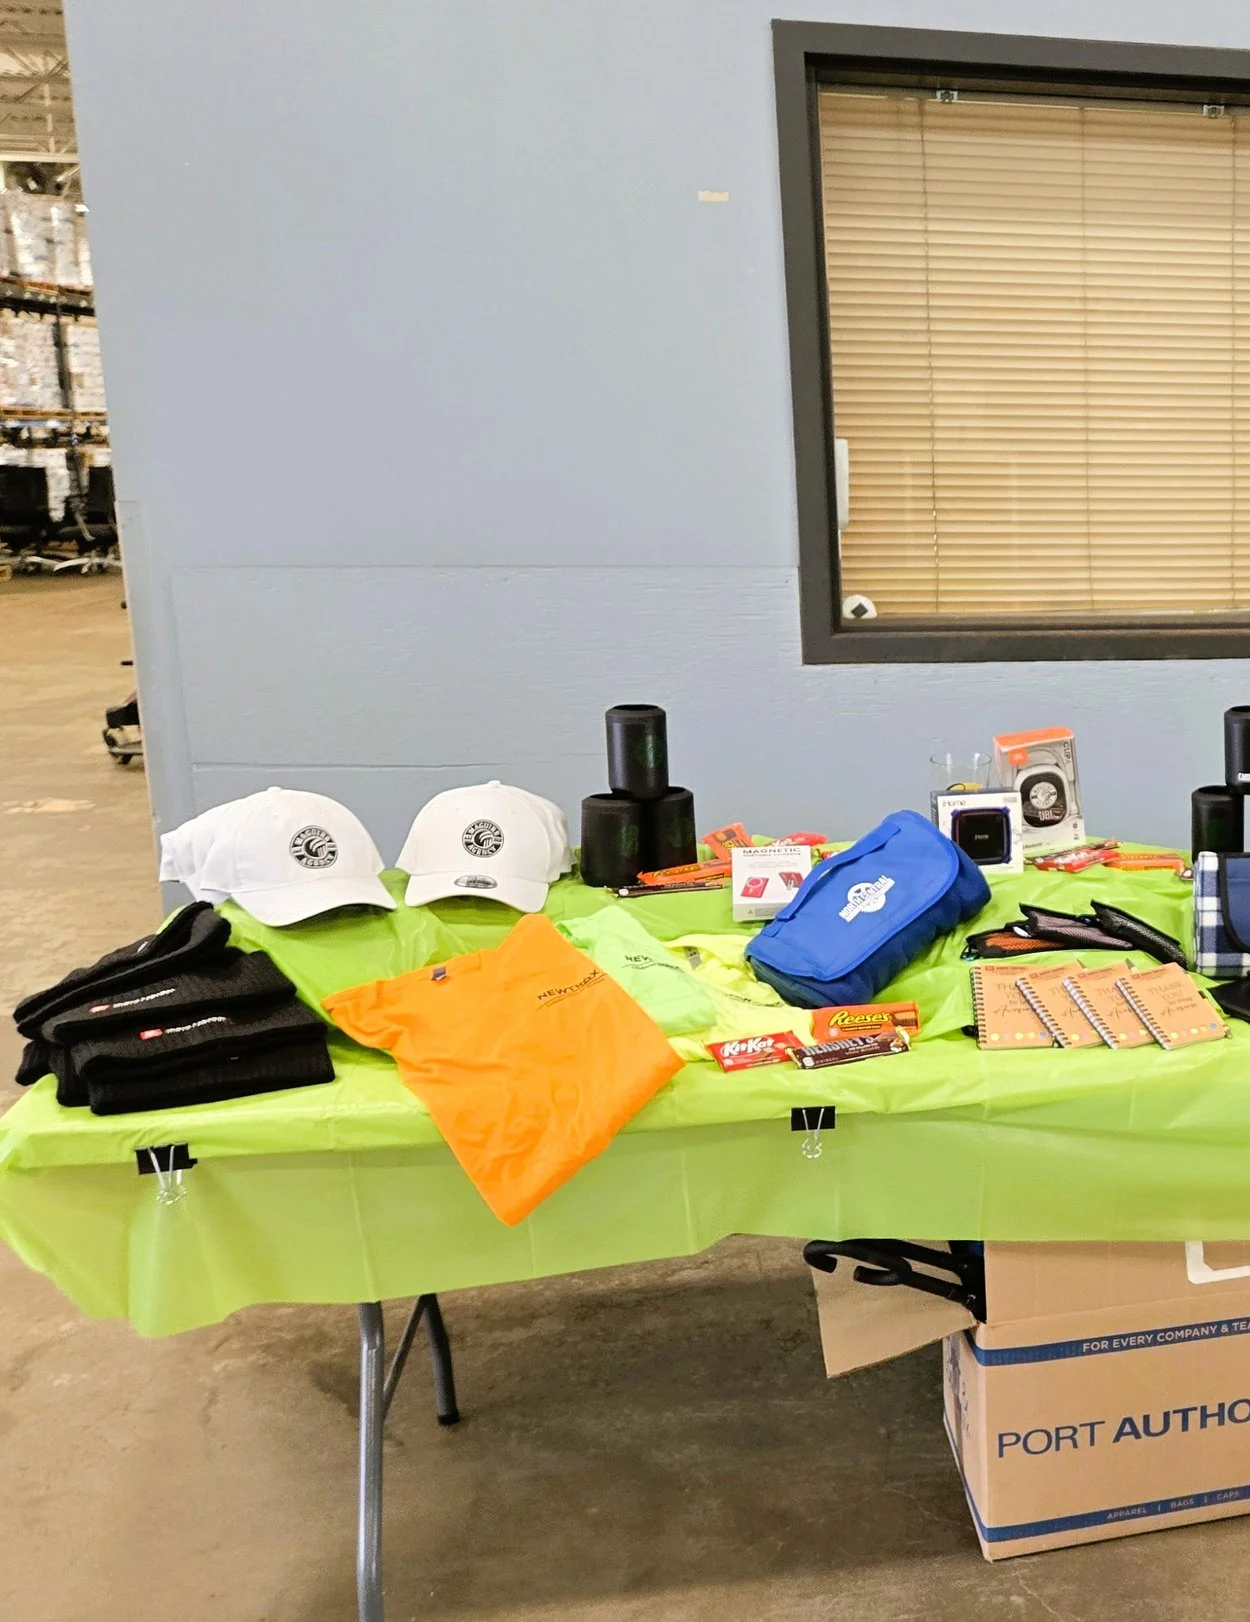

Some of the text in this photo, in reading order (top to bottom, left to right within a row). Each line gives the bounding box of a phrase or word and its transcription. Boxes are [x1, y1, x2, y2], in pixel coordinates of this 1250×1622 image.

[467, 843, 498, 856] AGENCY
[1147, 981, 1184, 996] THANK
[1161, 990, 1182, 1000] YOU
[829, 1010, 891, 1028] Reese's
[1082, 1341, 1109, 1352] FOR
[1112, 1334, 1154, 1349] EVERY
[1156, 1324, 1218, 1342] COMPANY
[1220, 1324, 1229, 1333] &
[997, 1421, 1105, 1458] PORT
[1107, 1490, 1241, 1520] APPAREL BAGS CAPS
